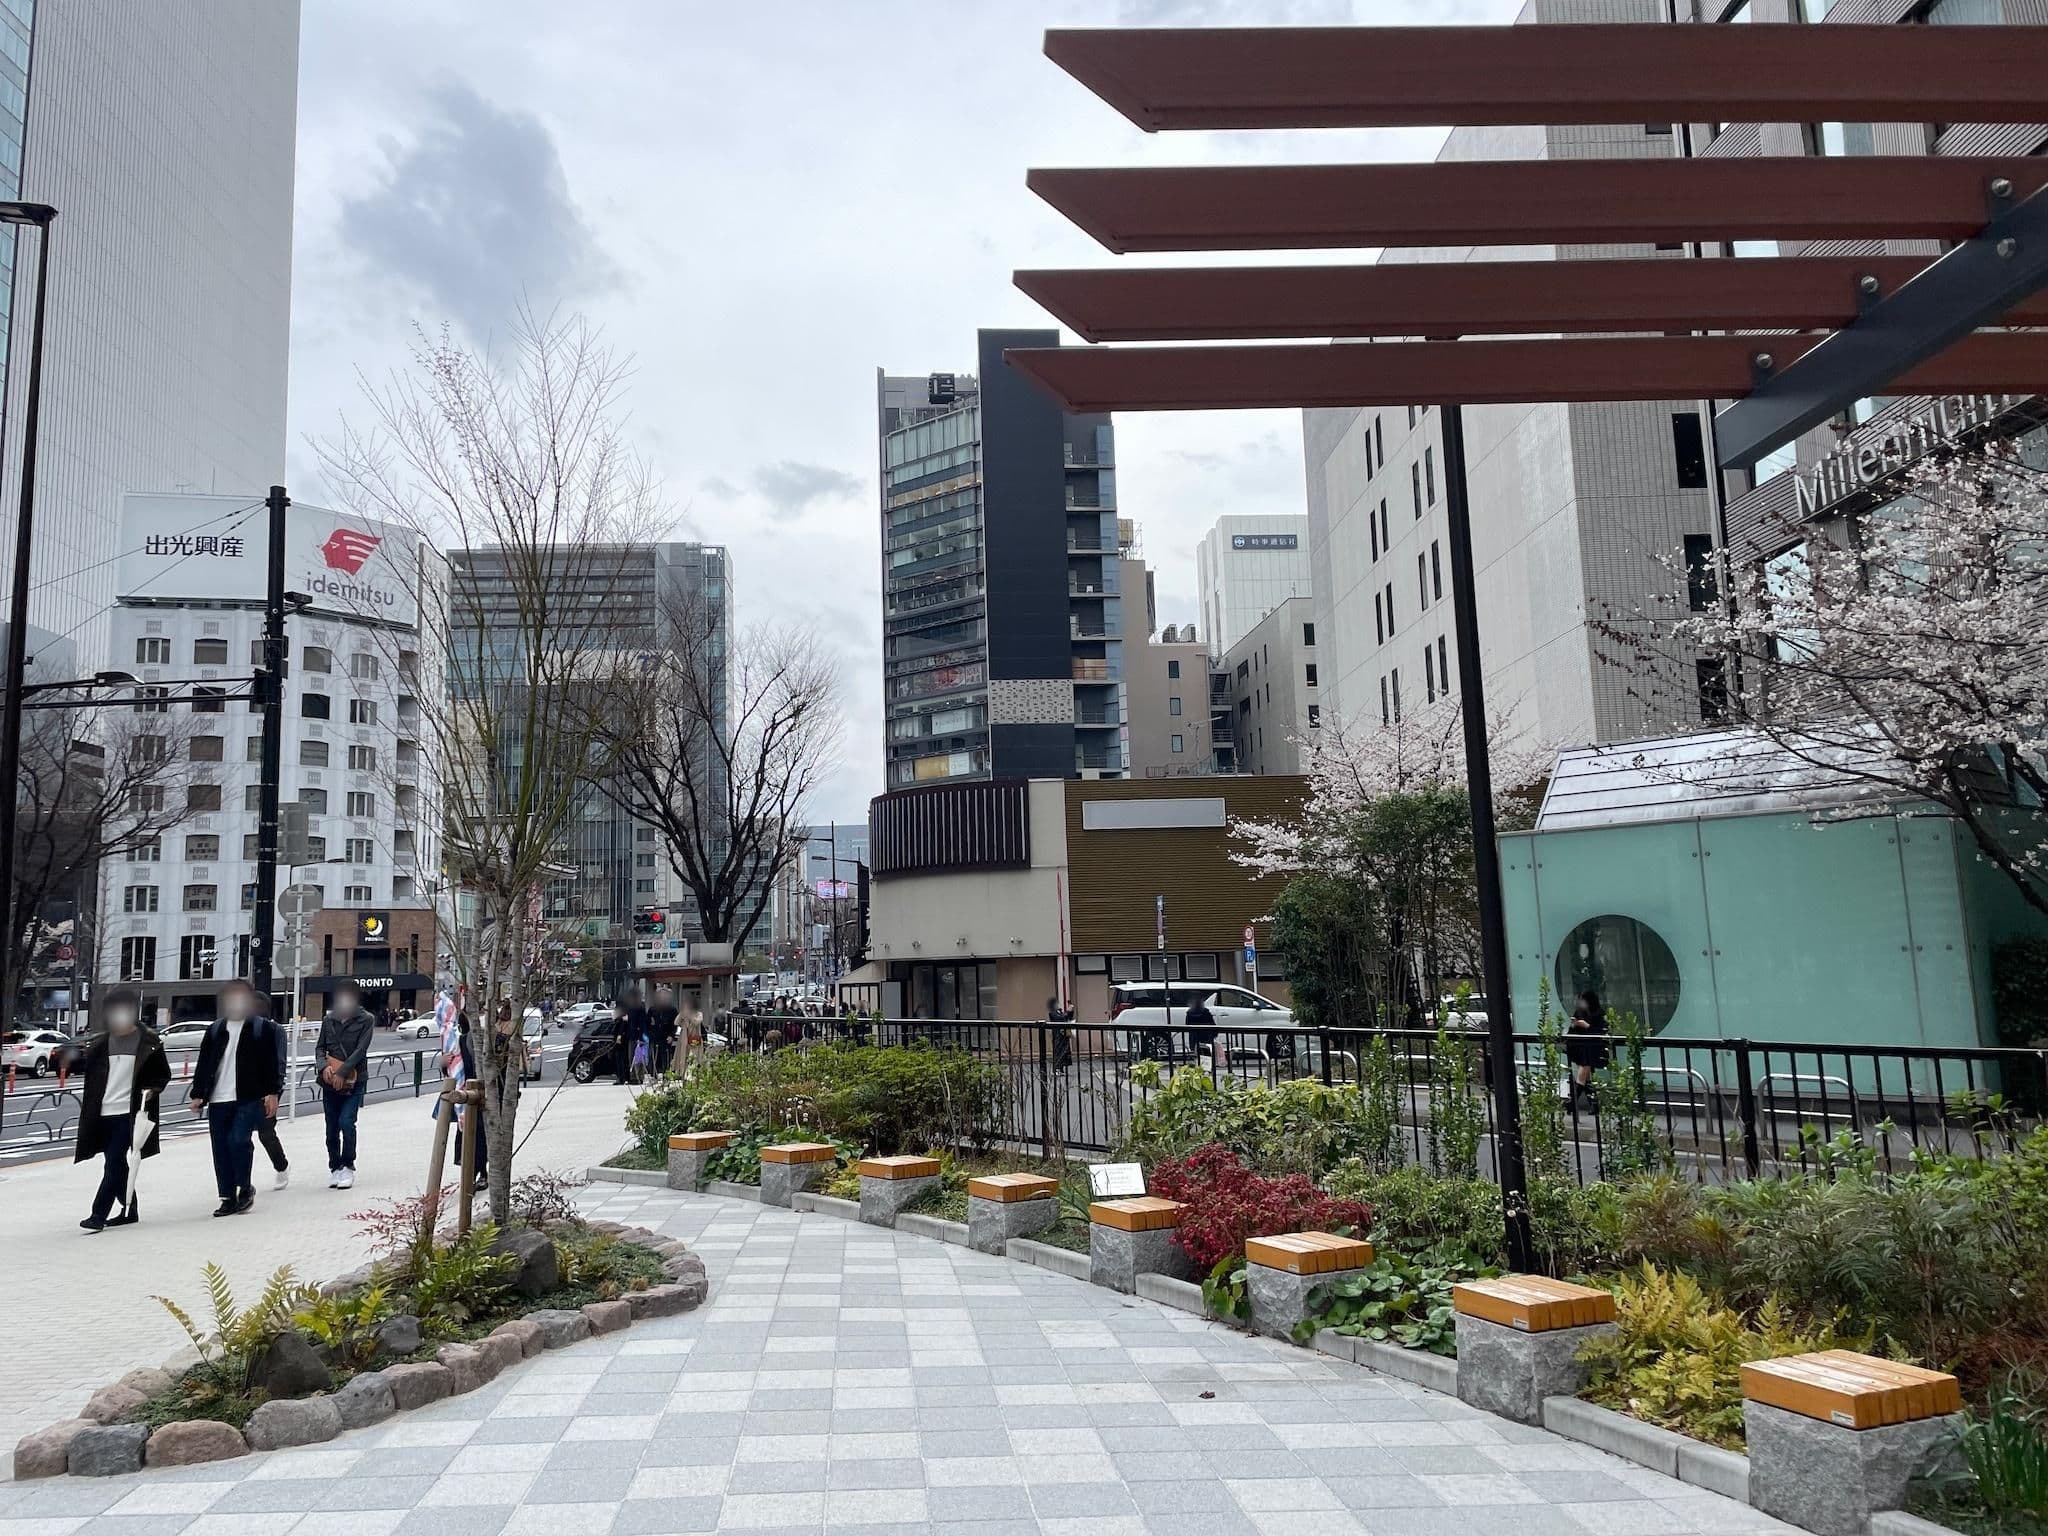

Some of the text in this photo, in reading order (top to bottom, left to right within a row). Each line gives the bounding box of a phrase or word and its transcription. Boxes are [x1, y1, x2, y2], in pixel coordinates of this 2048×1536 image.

[145, 534, 245, 558] 出光興産
[306, 571, 395, 606] idemitsu
